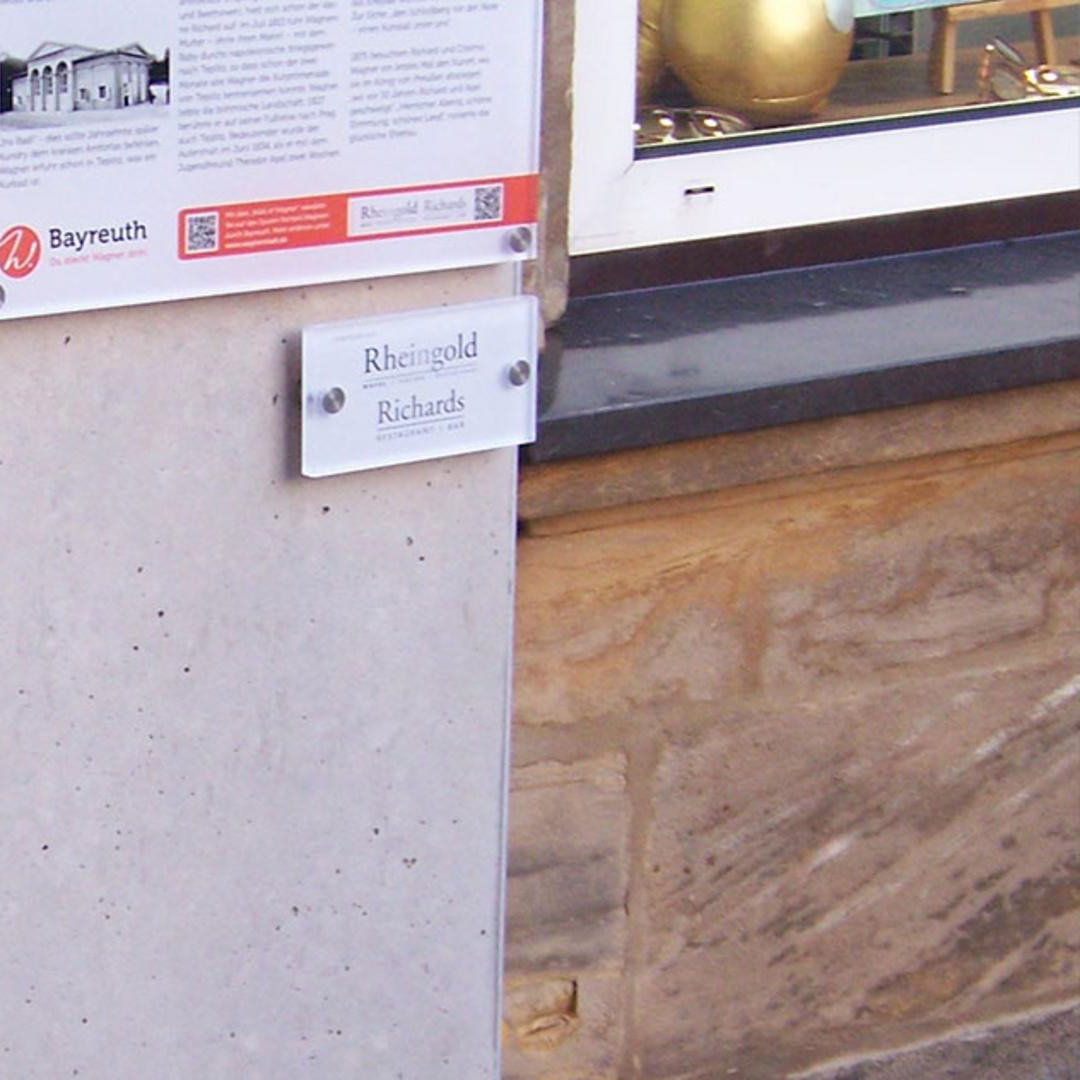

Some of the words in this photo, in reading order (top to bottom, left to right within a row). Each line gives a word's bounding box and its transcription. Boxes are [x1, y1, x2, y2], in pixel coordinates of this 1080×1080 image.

[49, 220, 148, 252] Bayreuth
[363, 331, 478, 374] Rheingold
[377, 388, 466, 425] Richards
